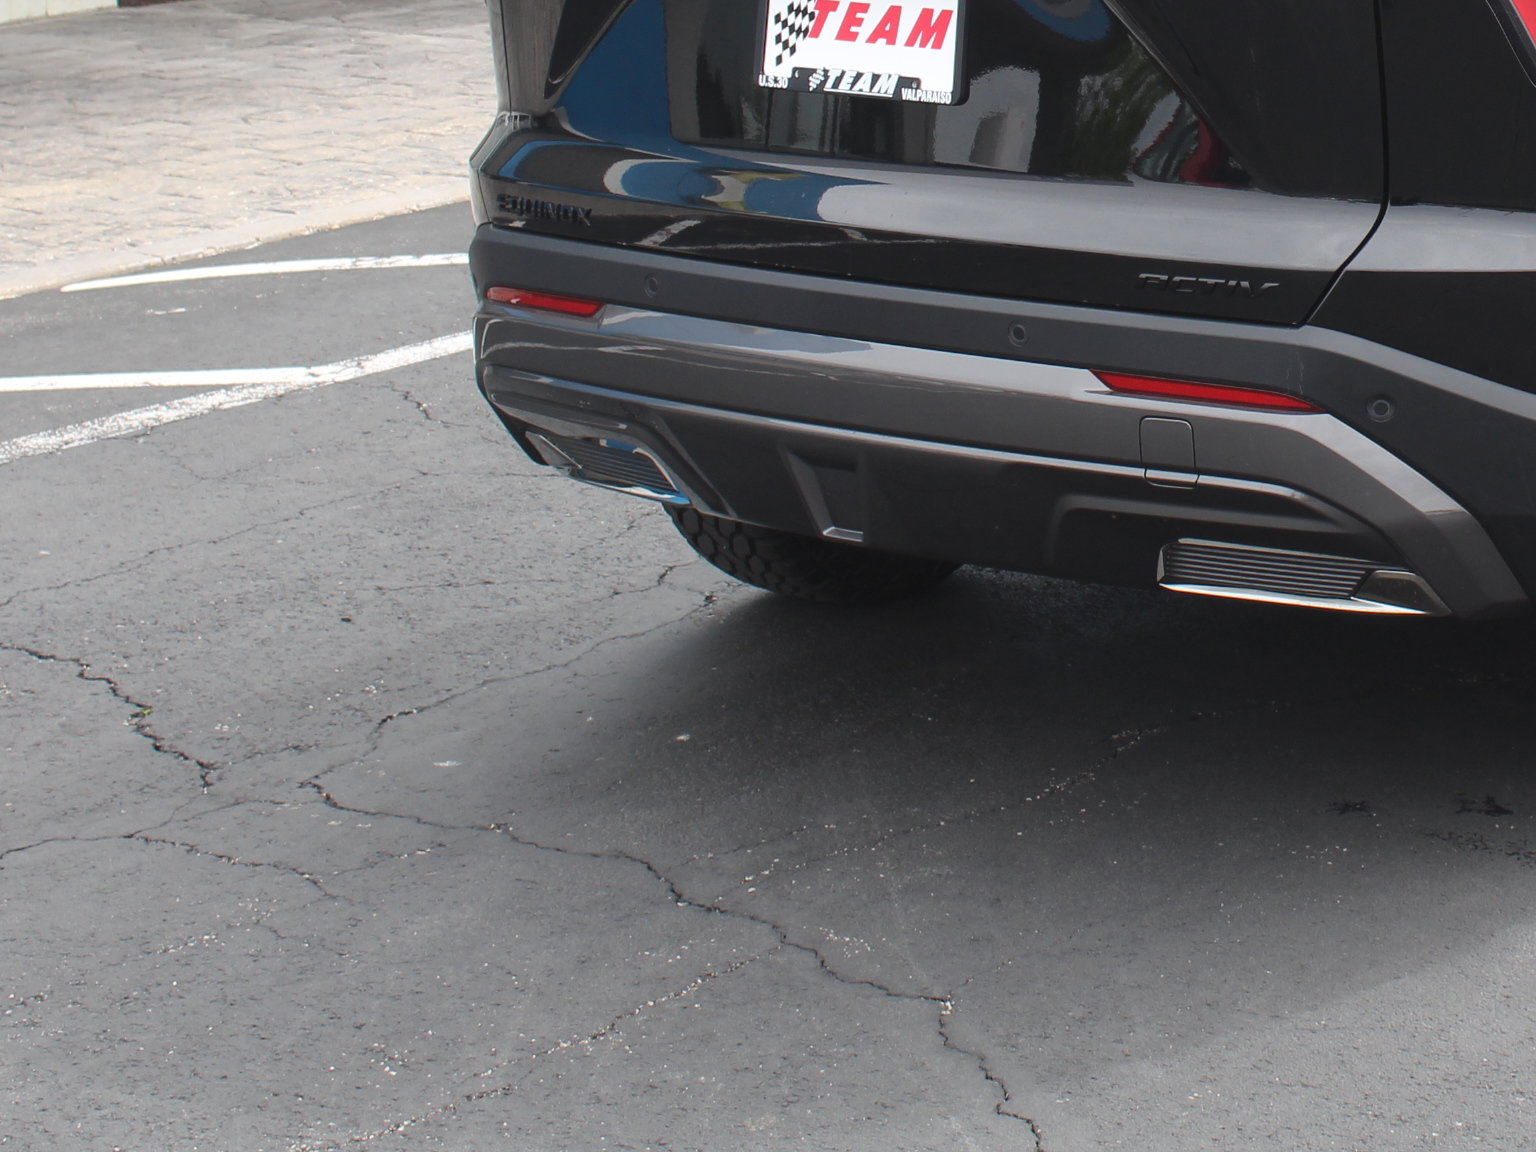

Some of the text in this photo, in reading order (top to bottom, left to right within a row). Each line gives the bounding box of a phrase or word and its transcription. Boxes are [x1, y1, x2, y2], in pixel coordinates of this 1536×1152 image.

[824, 68, 901, 96] TEAM
[902, 87, 952, 104] VALPARAISO
[1137, 273, 1280, 297] ACTIV
